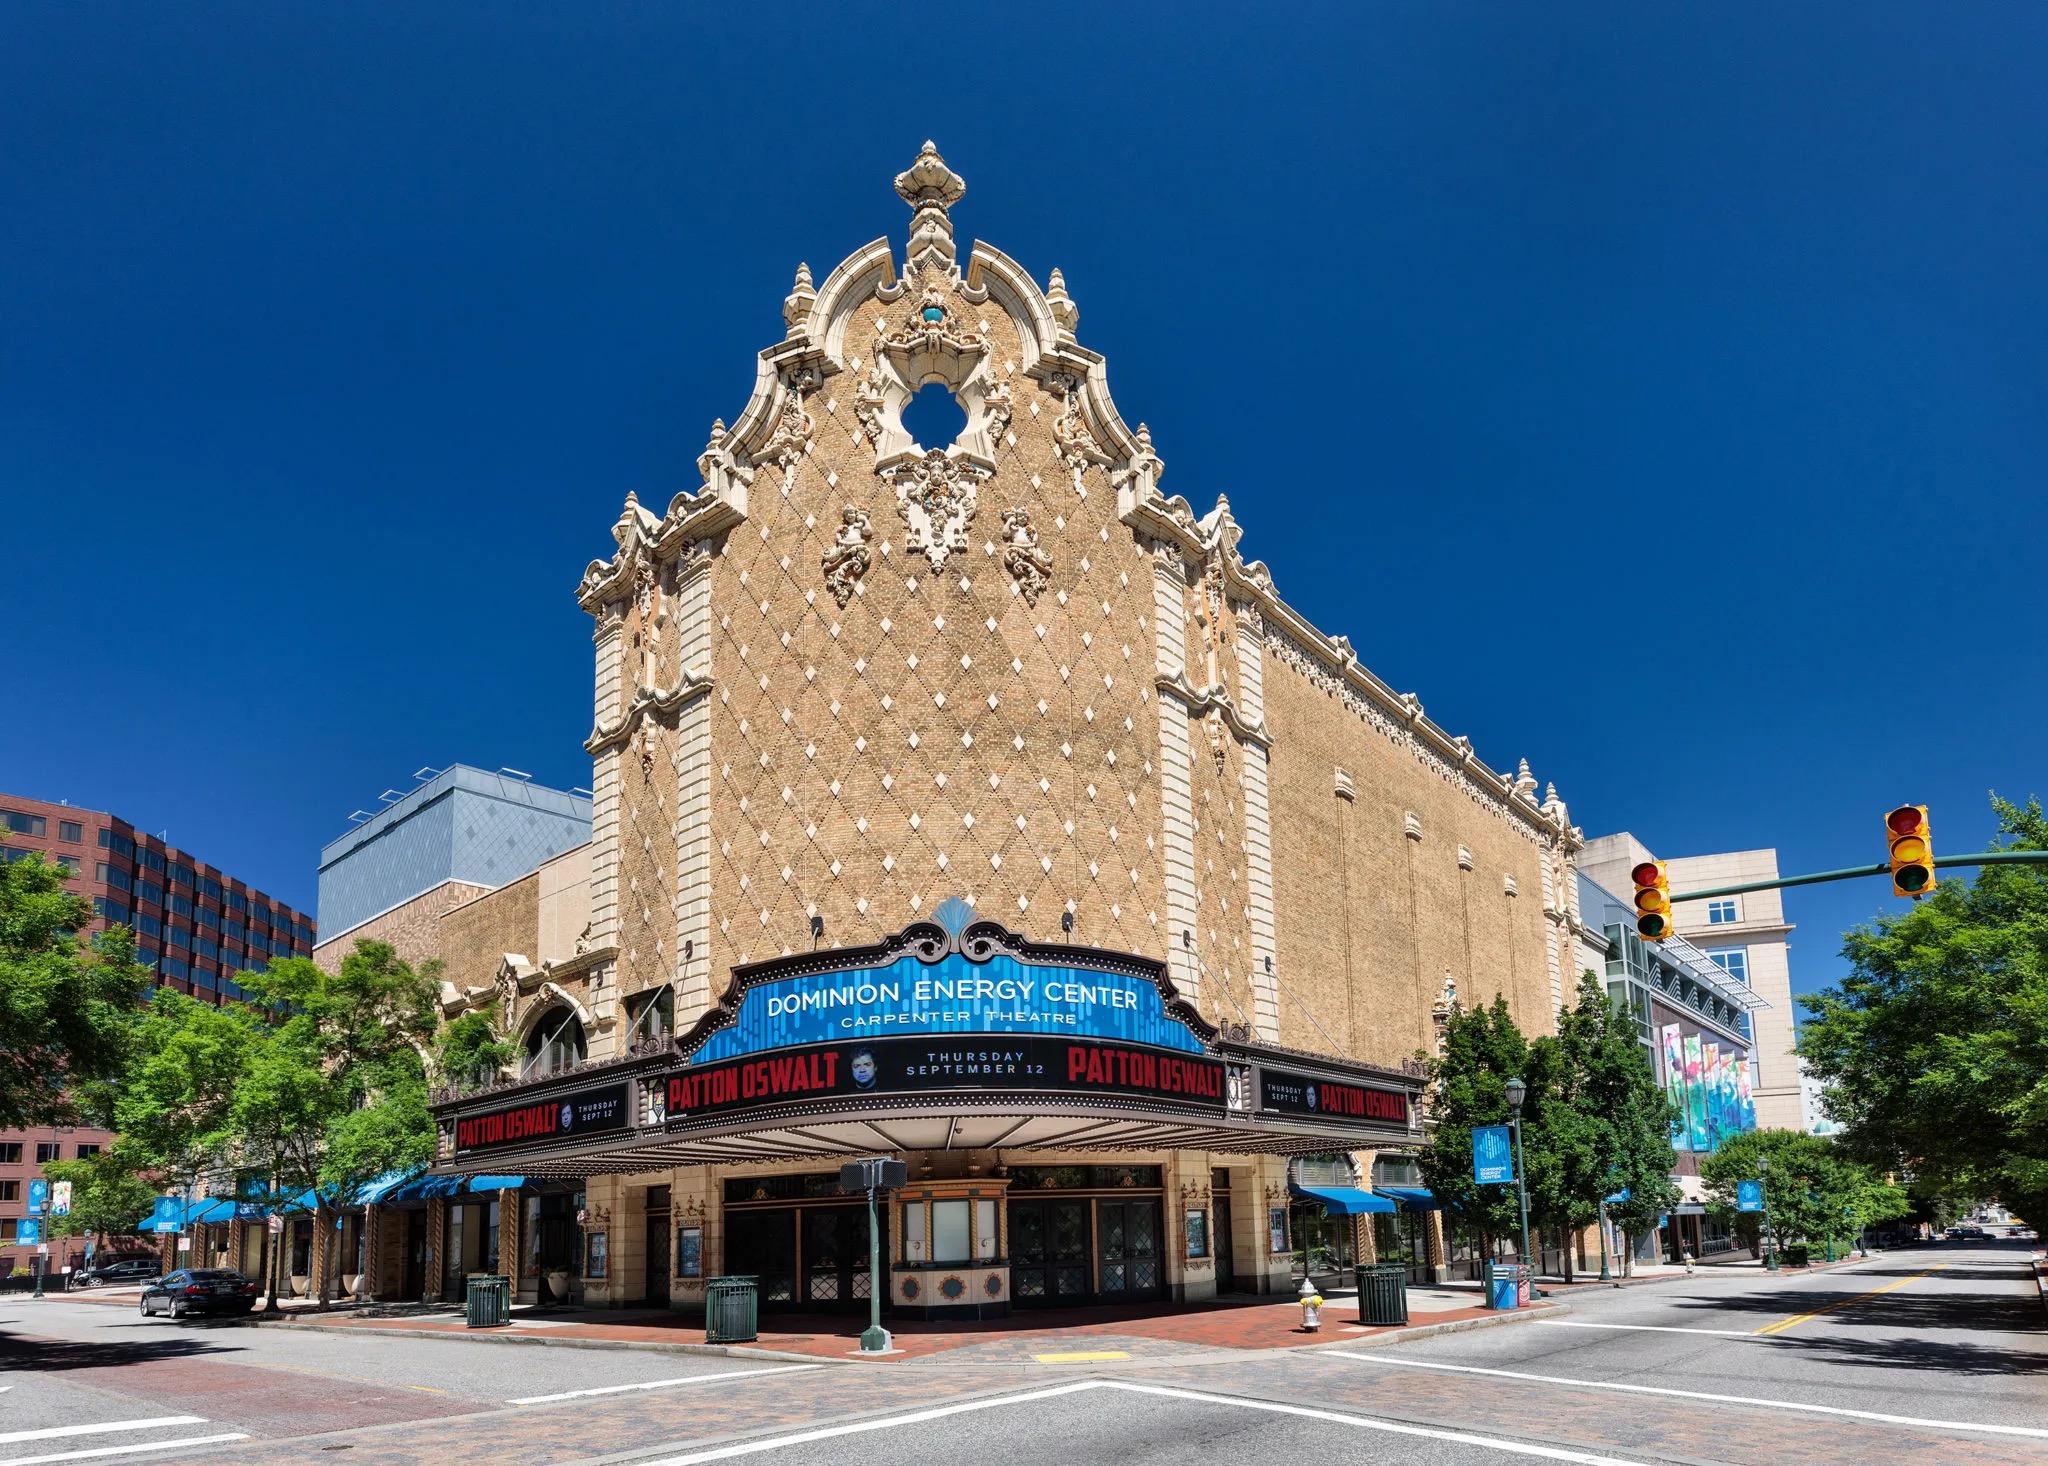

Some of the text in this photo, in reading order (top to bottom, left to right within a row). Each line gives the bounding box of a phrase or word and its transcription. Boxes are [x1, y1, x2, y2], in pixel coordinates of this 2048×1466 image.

[768, 979, 1138, 1017] DOMINION ENERGY CENTER
[841, 1011, 1077, 1028] CARPENTER THEATRE
[927, 1052, 1023, 1062] THURSDAY
[906, 1064, 1043, 1075] SEPTEMBER 12
[1067, 1046, 1223, 1098] PATTON OSWALT
[669, 1052, 839, 1111] PATTON OSWALT
[1267, 1083, 1301, 1095] THURSDAY
[1271, 1093, 1299, 1103] SEPT 12
[1321, 1084, 1405, 1121] PATTON OSWALT
[578, 1100, 617, 1113] THURSDAY
[582, 1110, 613, 1121] SEPT 12
[458, 1103, 559, 1148] PATTON OSWALT
